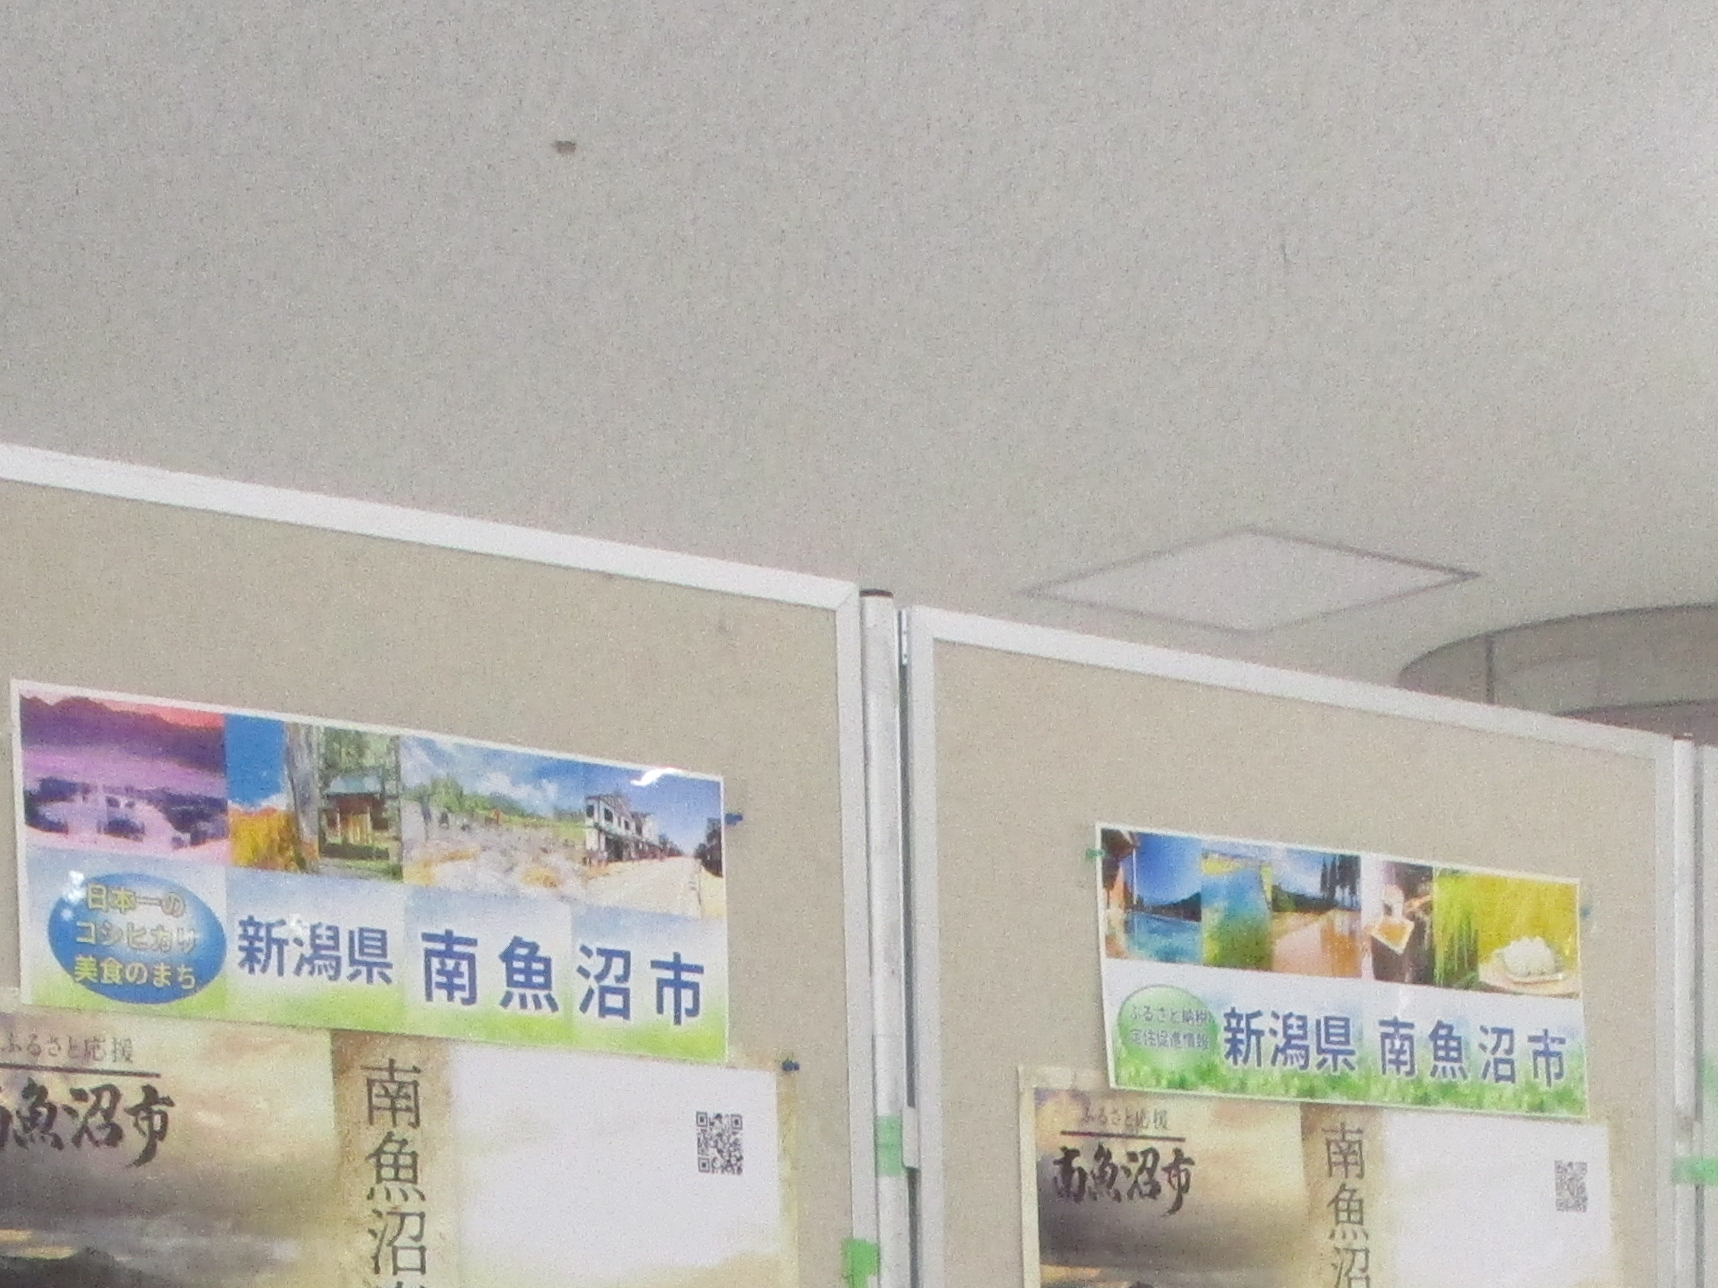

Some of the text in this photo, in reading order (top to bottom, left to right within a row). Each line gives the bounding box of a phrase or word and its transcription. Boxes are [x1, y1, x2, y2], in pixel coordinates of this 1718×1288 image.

[86, 882, 187, 919] 日本一の
[73, 954, 198, 990] 美食のまち
[236, 914, 706, 1028] 新潟県 南魚沼市
[1, 1032, 134, 1063] ふるさと応援
[1222, 1005, 1568, 1090] 新潟県 南魚沼市
[1052, 1141, 1196, 1218] 南魚沼市
